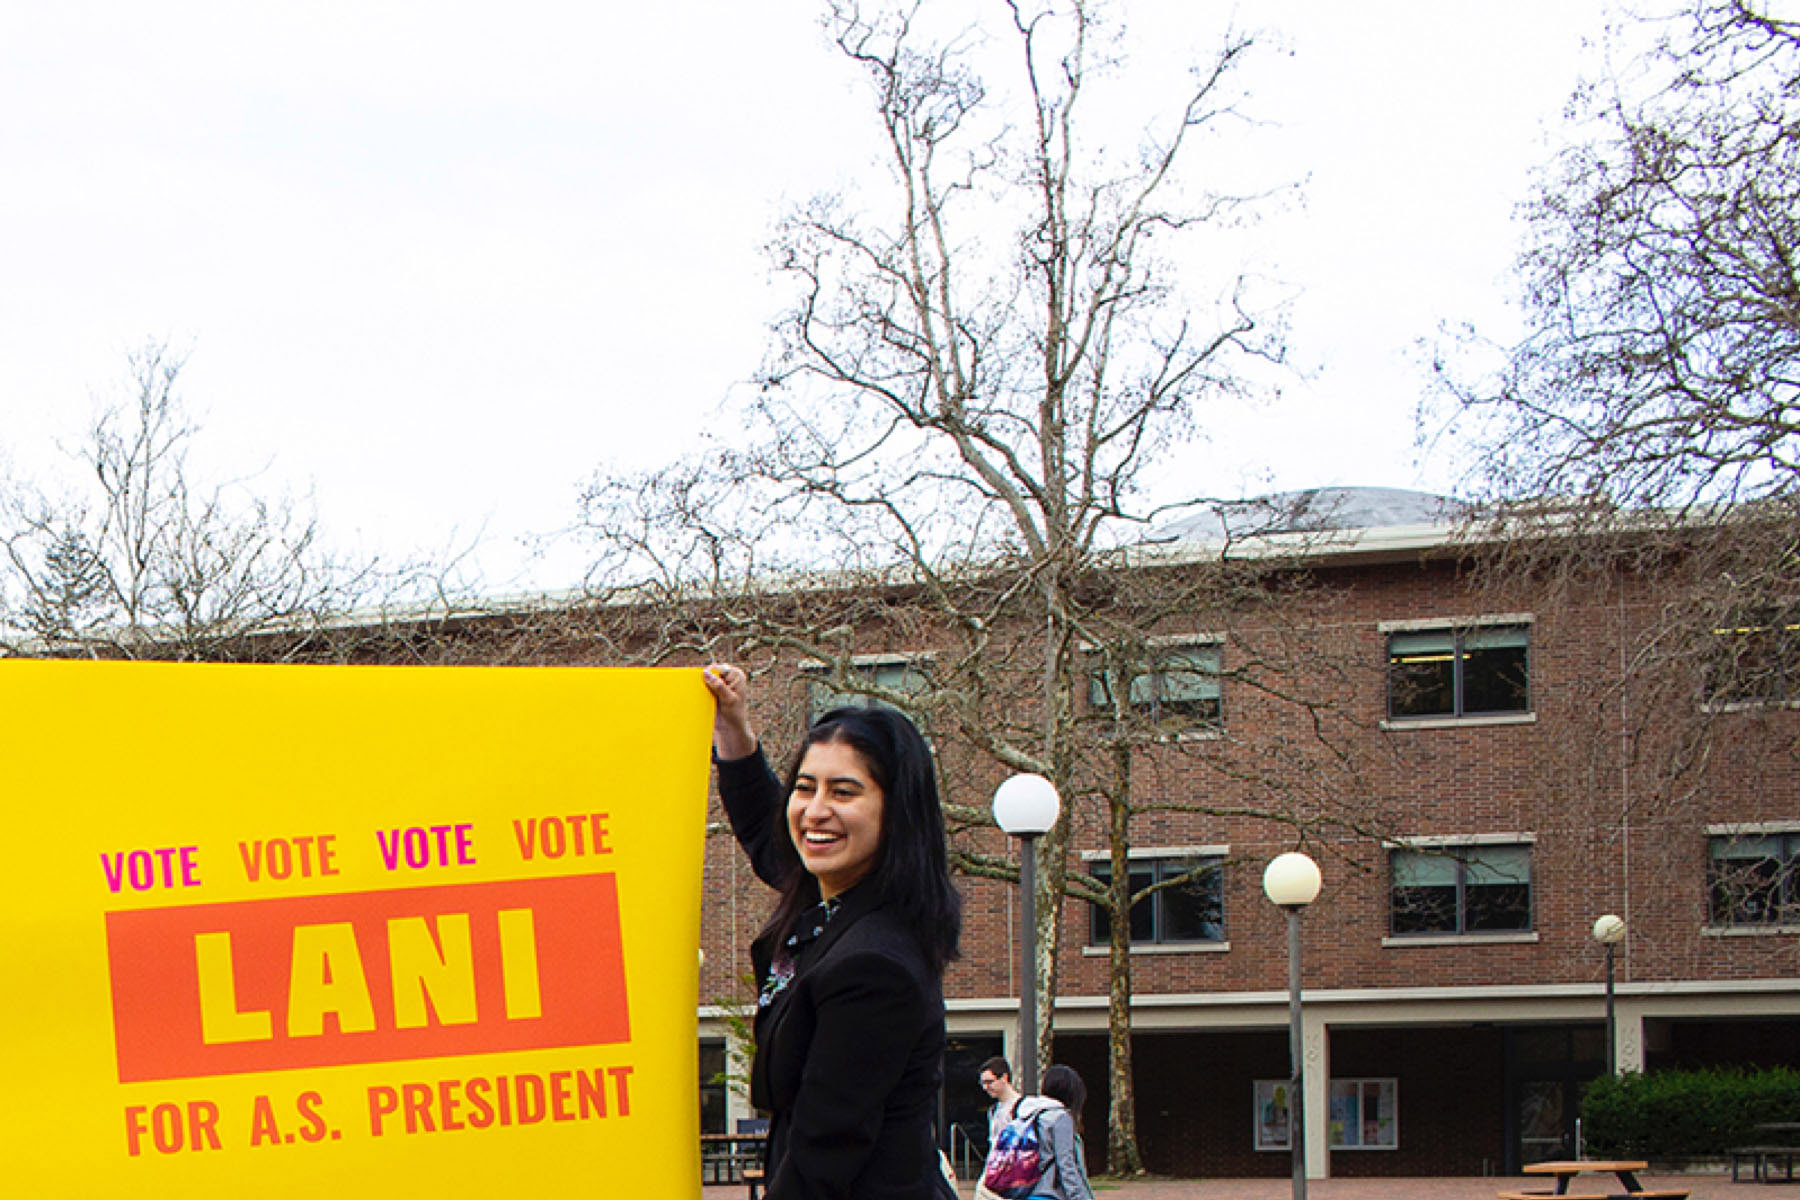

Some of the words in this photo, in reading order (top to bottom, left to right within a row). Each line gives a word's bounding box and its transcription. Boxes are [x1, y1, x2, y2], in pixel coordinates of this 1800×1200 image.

[99, 845, 202, 894] VOTE
[238, 834, 340, 882] VOTE
[375, 822, 477, 872] VOTE
[512, 812, 614, 861] VOTE
[194, 908, 542, 1045] LANI
[124, 1100, 222, 1157] FOR
[250, 1090, 342, 1147] A.S.
[367, 1065, 635, 1137] PRESIDENT
